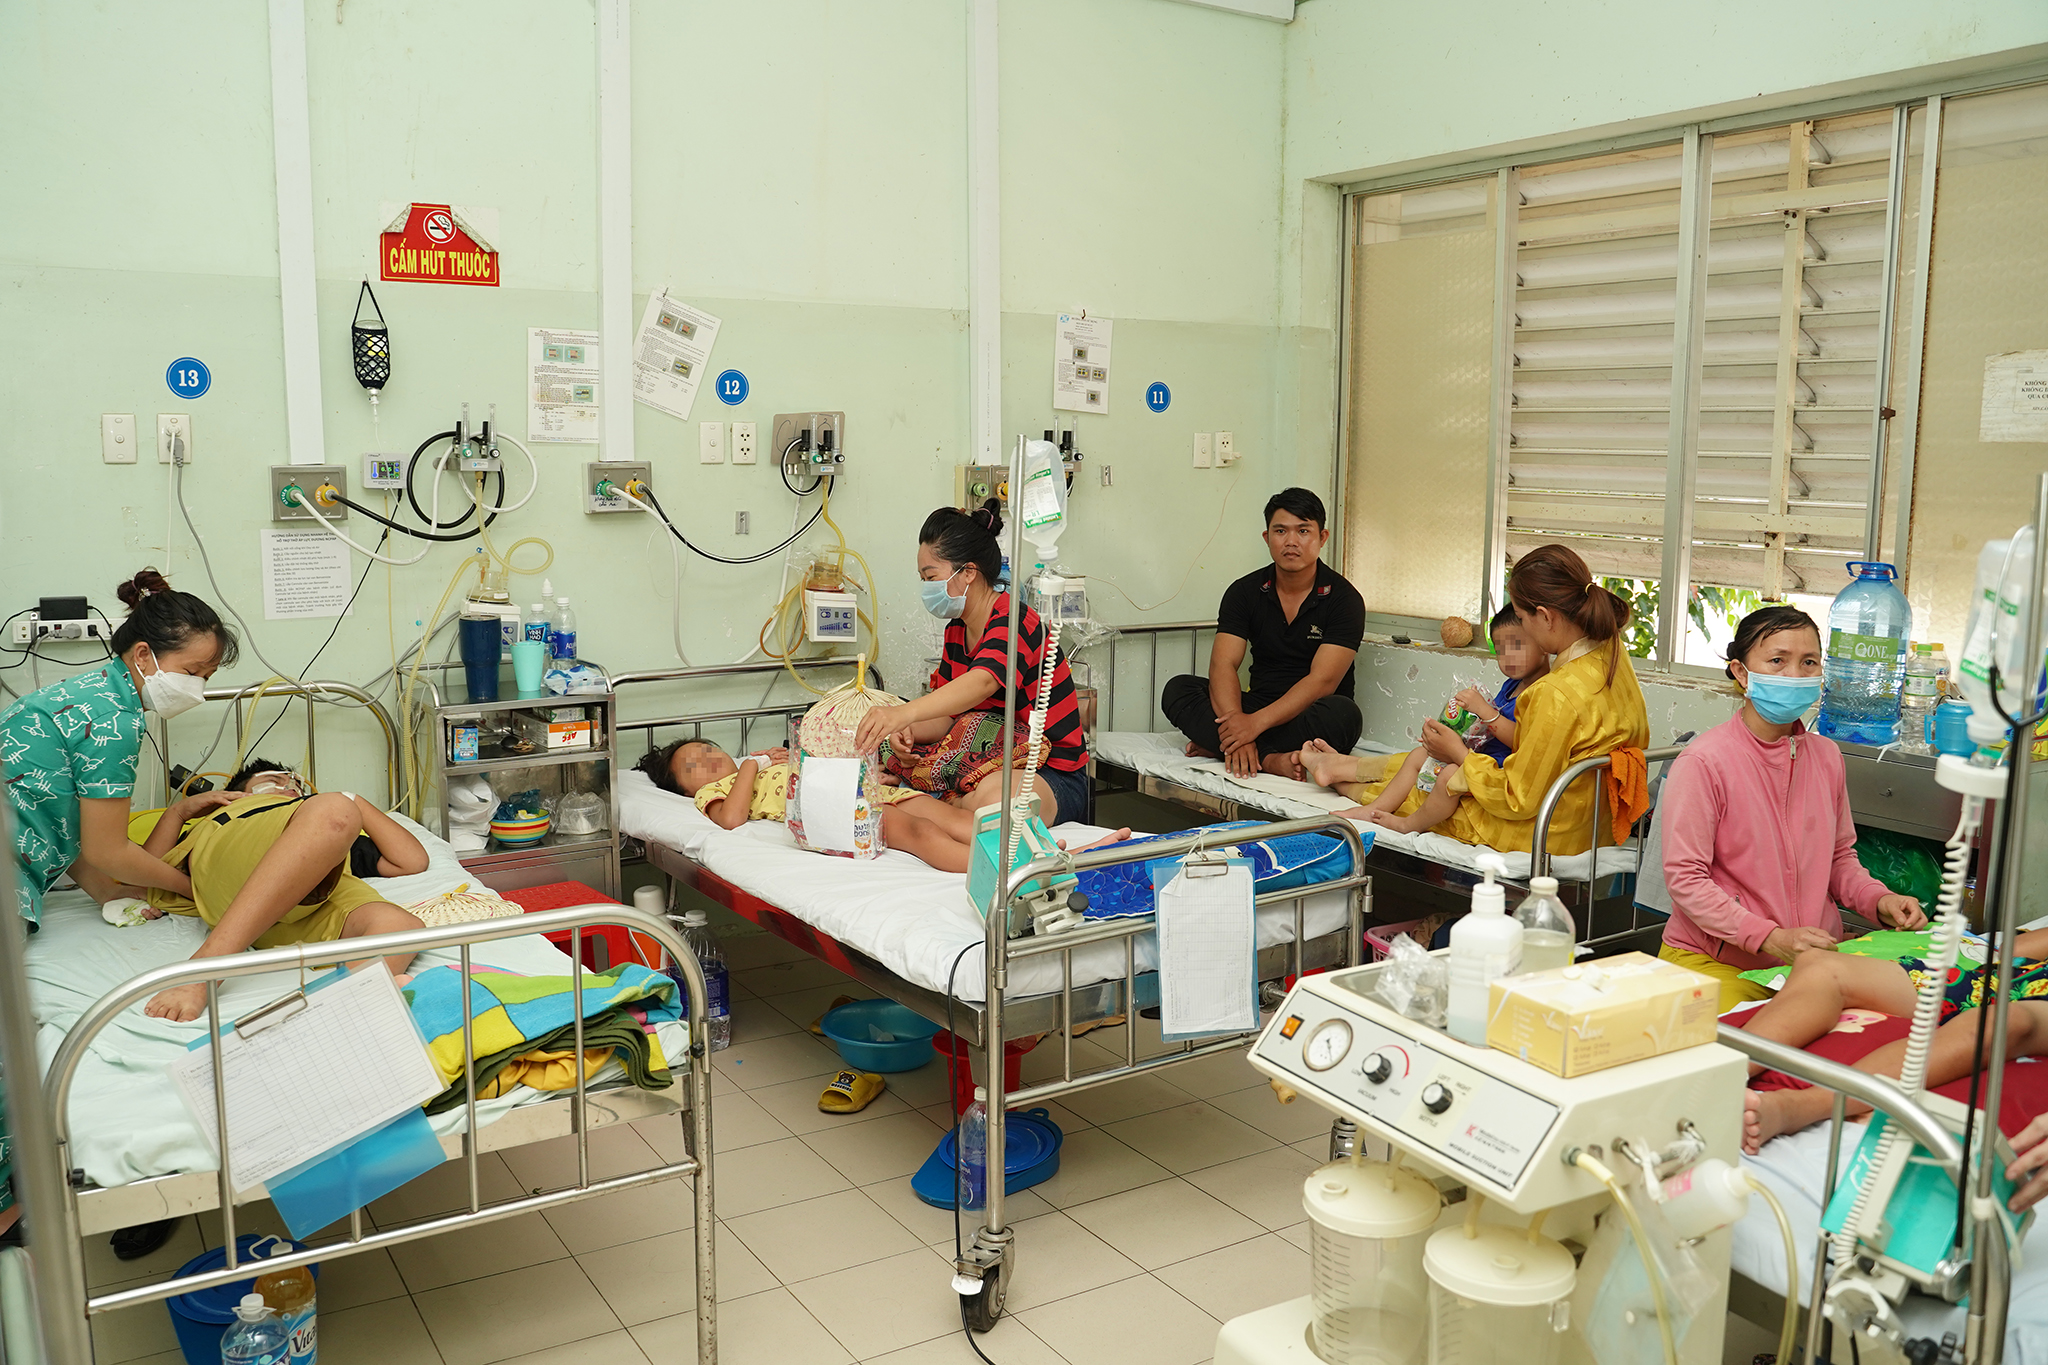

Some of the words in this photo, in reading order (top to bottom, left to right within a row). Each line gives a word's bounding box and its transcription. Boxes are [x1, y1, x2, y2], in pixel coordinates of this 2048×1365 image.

[390, 237, 417, 274] CẤM
[420, 243, 446, 275] HÚT
[178, 369, 199, 387] 13
[725, 380, 740, 395] 12
[1152, 391, 1165, 404] 11
[561, 731, 578, 743] AFC
[1437, 1073, 1451, 1083] LEFT
[1455, 1081, 1472, 1093] RIGHT
[1418, 1113, 1439, 1129] BOTTLE
[1448, 1141, 1471, 1158] MOBILE
[1471, 1152, 1498, 1171] SUCTION
